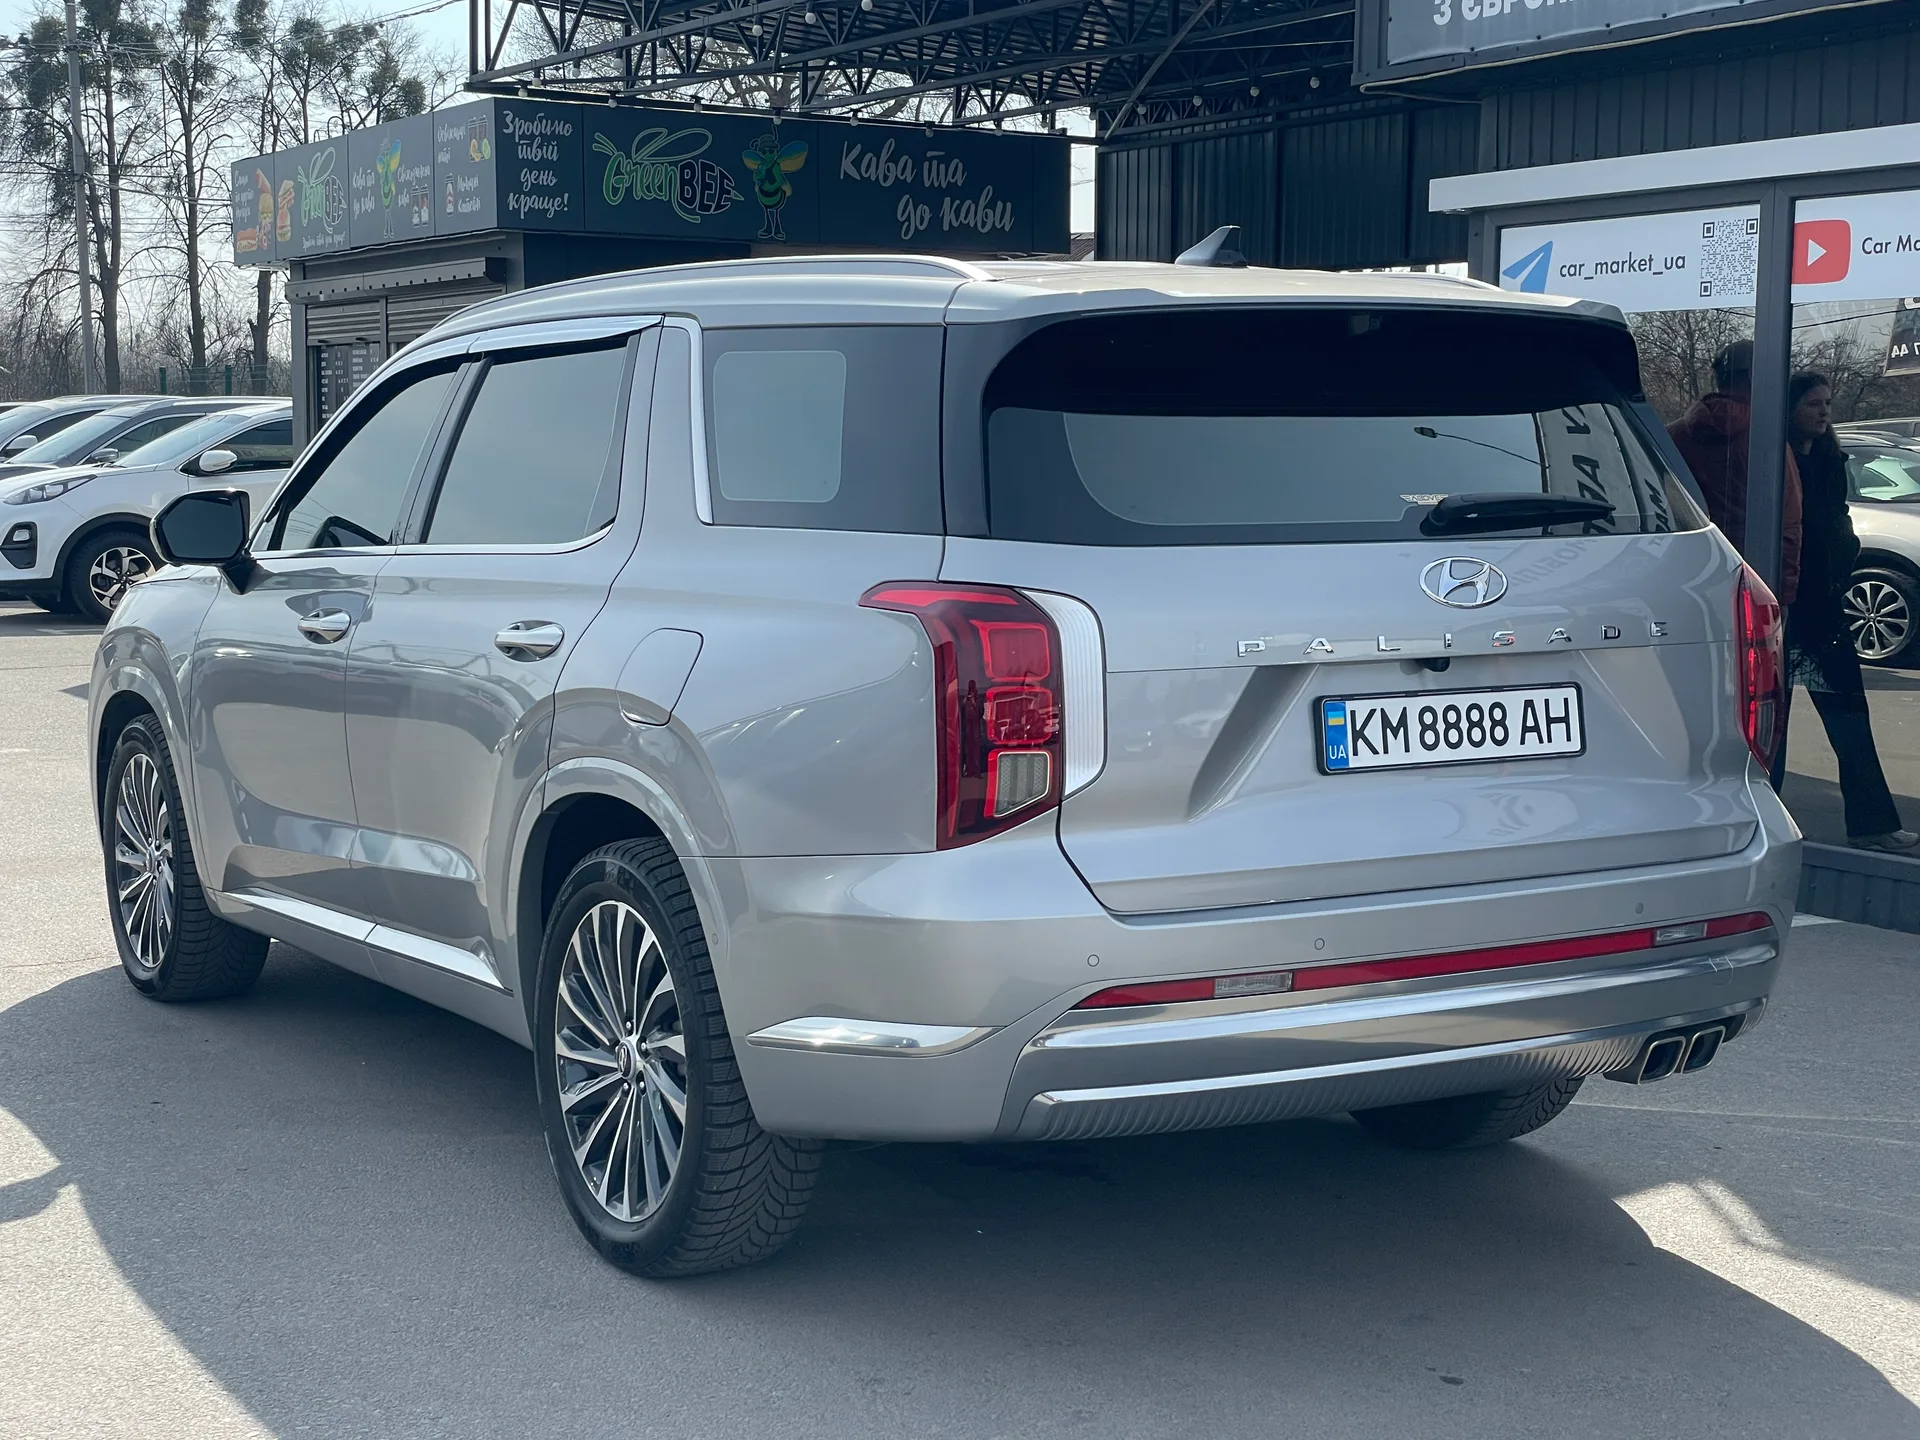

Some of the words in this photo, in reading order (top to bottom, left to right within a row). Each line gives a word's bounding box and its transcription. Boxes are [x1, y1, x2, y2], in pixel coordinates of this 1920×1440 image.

[502, 110, 573, 142] Зробимо
[517, 137, 560, 162] твій
[840, 138, 916, 187] Кава
[923, 151, 967, 188] та
[520, 166, 558, 192] день
[507, 192, 569, 219] краще!
[897, 195, 932, 240] до
[940, 185, 1014, 233] кави
[1862, 237, 1892, 255] Car
[1559, 252, 1686, 280] car_market_ua
[1237, 621, 1669, 657] PALISADE
[1350, 706, 1410, 757] KM
[1418, 701, 1510, 751] 8888
[1519, 697, 1572, 746] AH
[1329, 744, 1347, 760] UA
